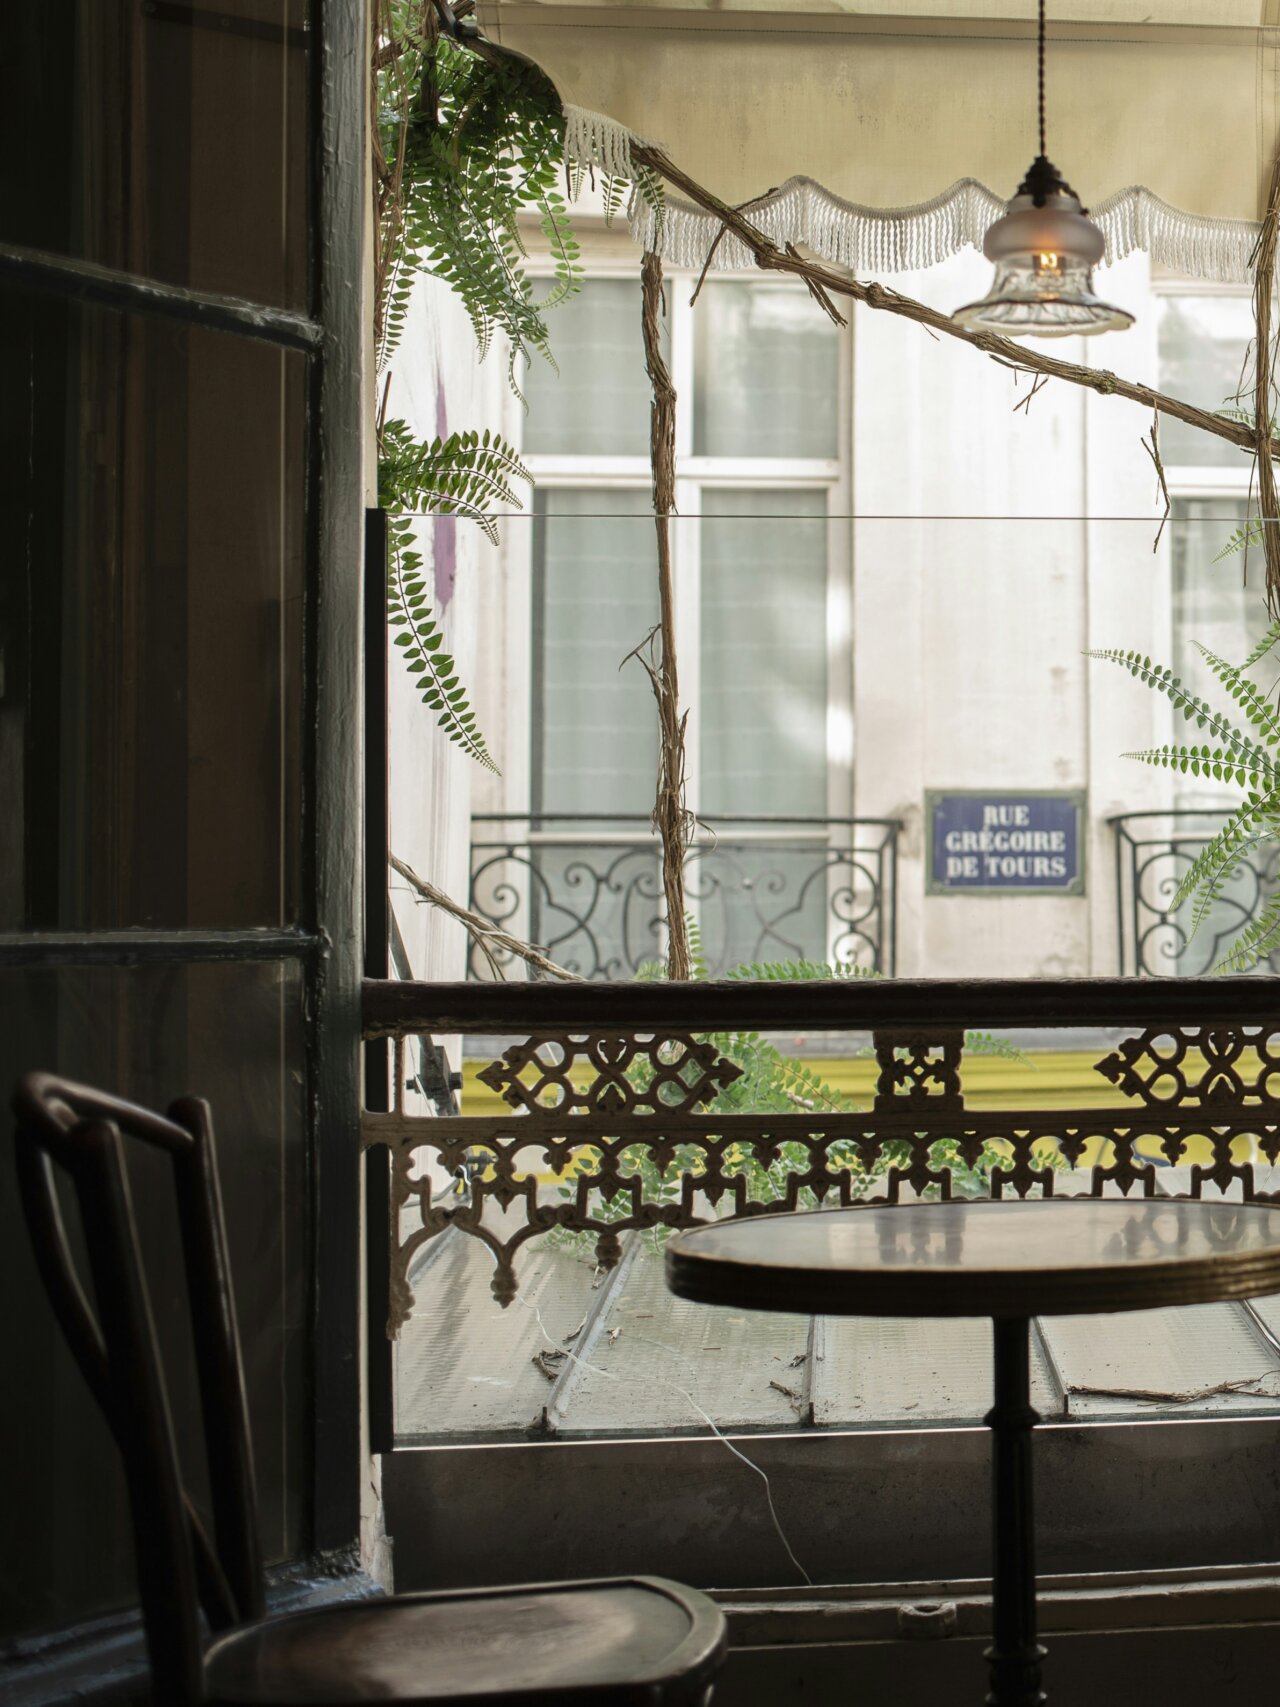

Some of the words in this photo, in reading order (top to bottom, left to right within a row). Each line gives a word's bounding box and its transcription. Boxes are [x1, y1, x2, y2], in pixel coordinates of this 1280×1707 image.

[983, 805, 1029, 826] RUE
[945, 825, 1066, 852] GRÉGOIRE
[947, 856, 979, 878] DE
[987, 856, 1067, 878] TOURS
